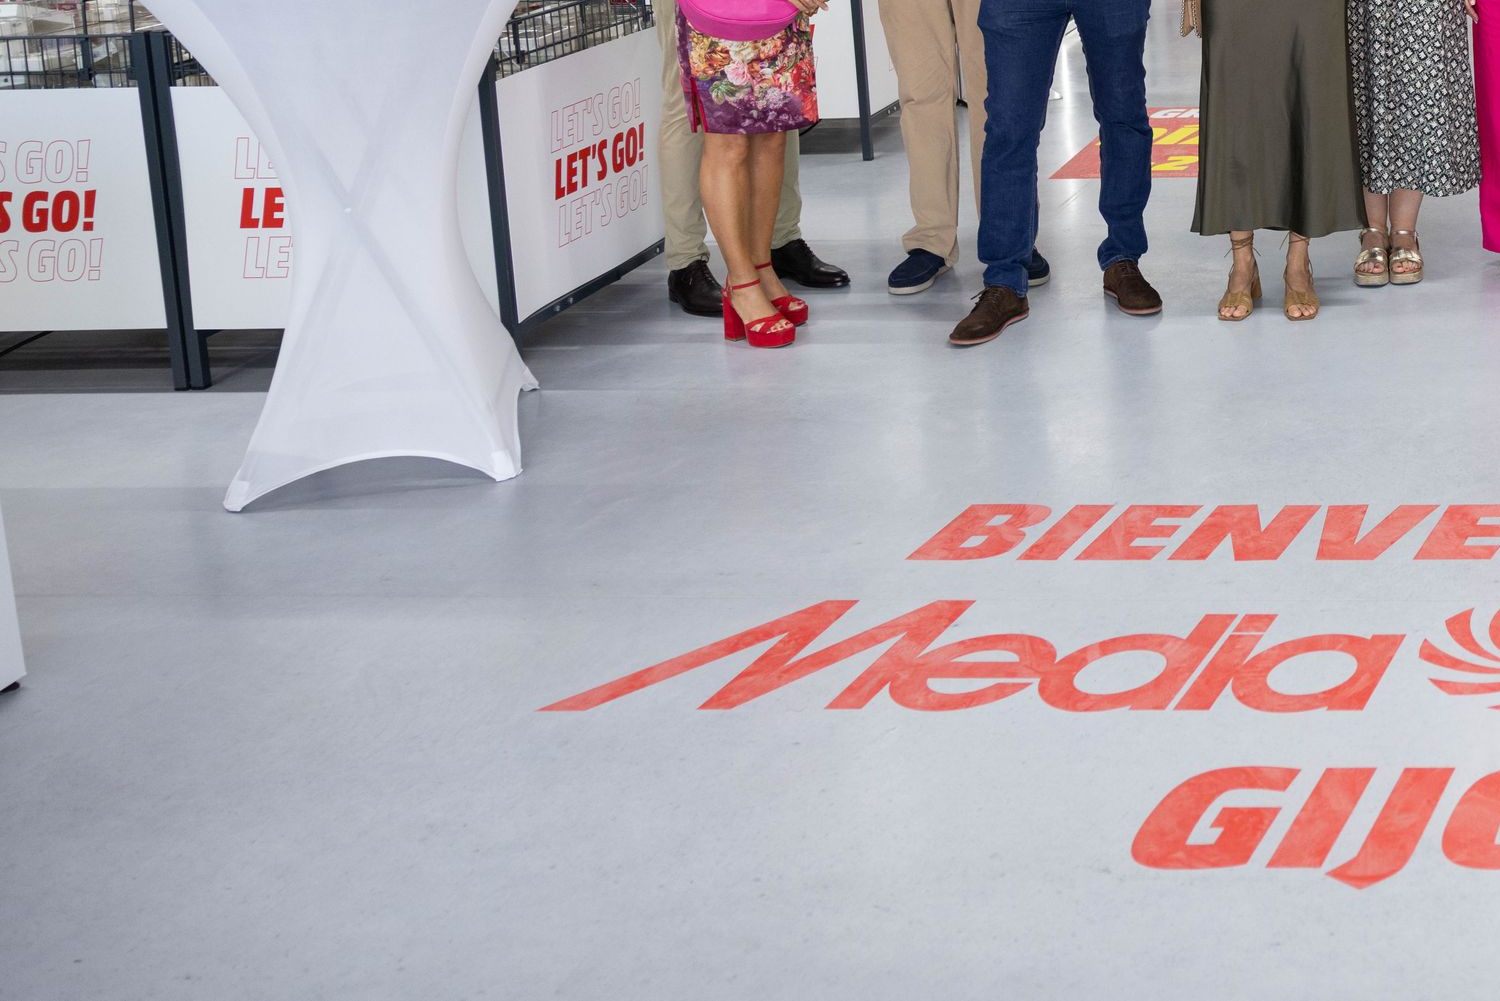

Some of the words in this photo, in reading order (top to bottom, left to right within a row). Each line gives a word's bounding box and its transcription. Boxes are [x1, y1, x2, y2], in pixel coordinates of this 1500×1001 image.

[551, 93, 603, 154] LET'S
[608, 77, 641, 129] GO!
[15, 139, 91, 184] GO!
[555, 139, 608, 201] LET'S
[612, 122, 644, 173] GO!
[22, 189, 97, 232] GO!
[558, 183, 612, 248] LET'S
[615, 164, 649, 219] GO!
[27, 238, 103, 282] GO!
[535, 599, 1406, 713] Media
